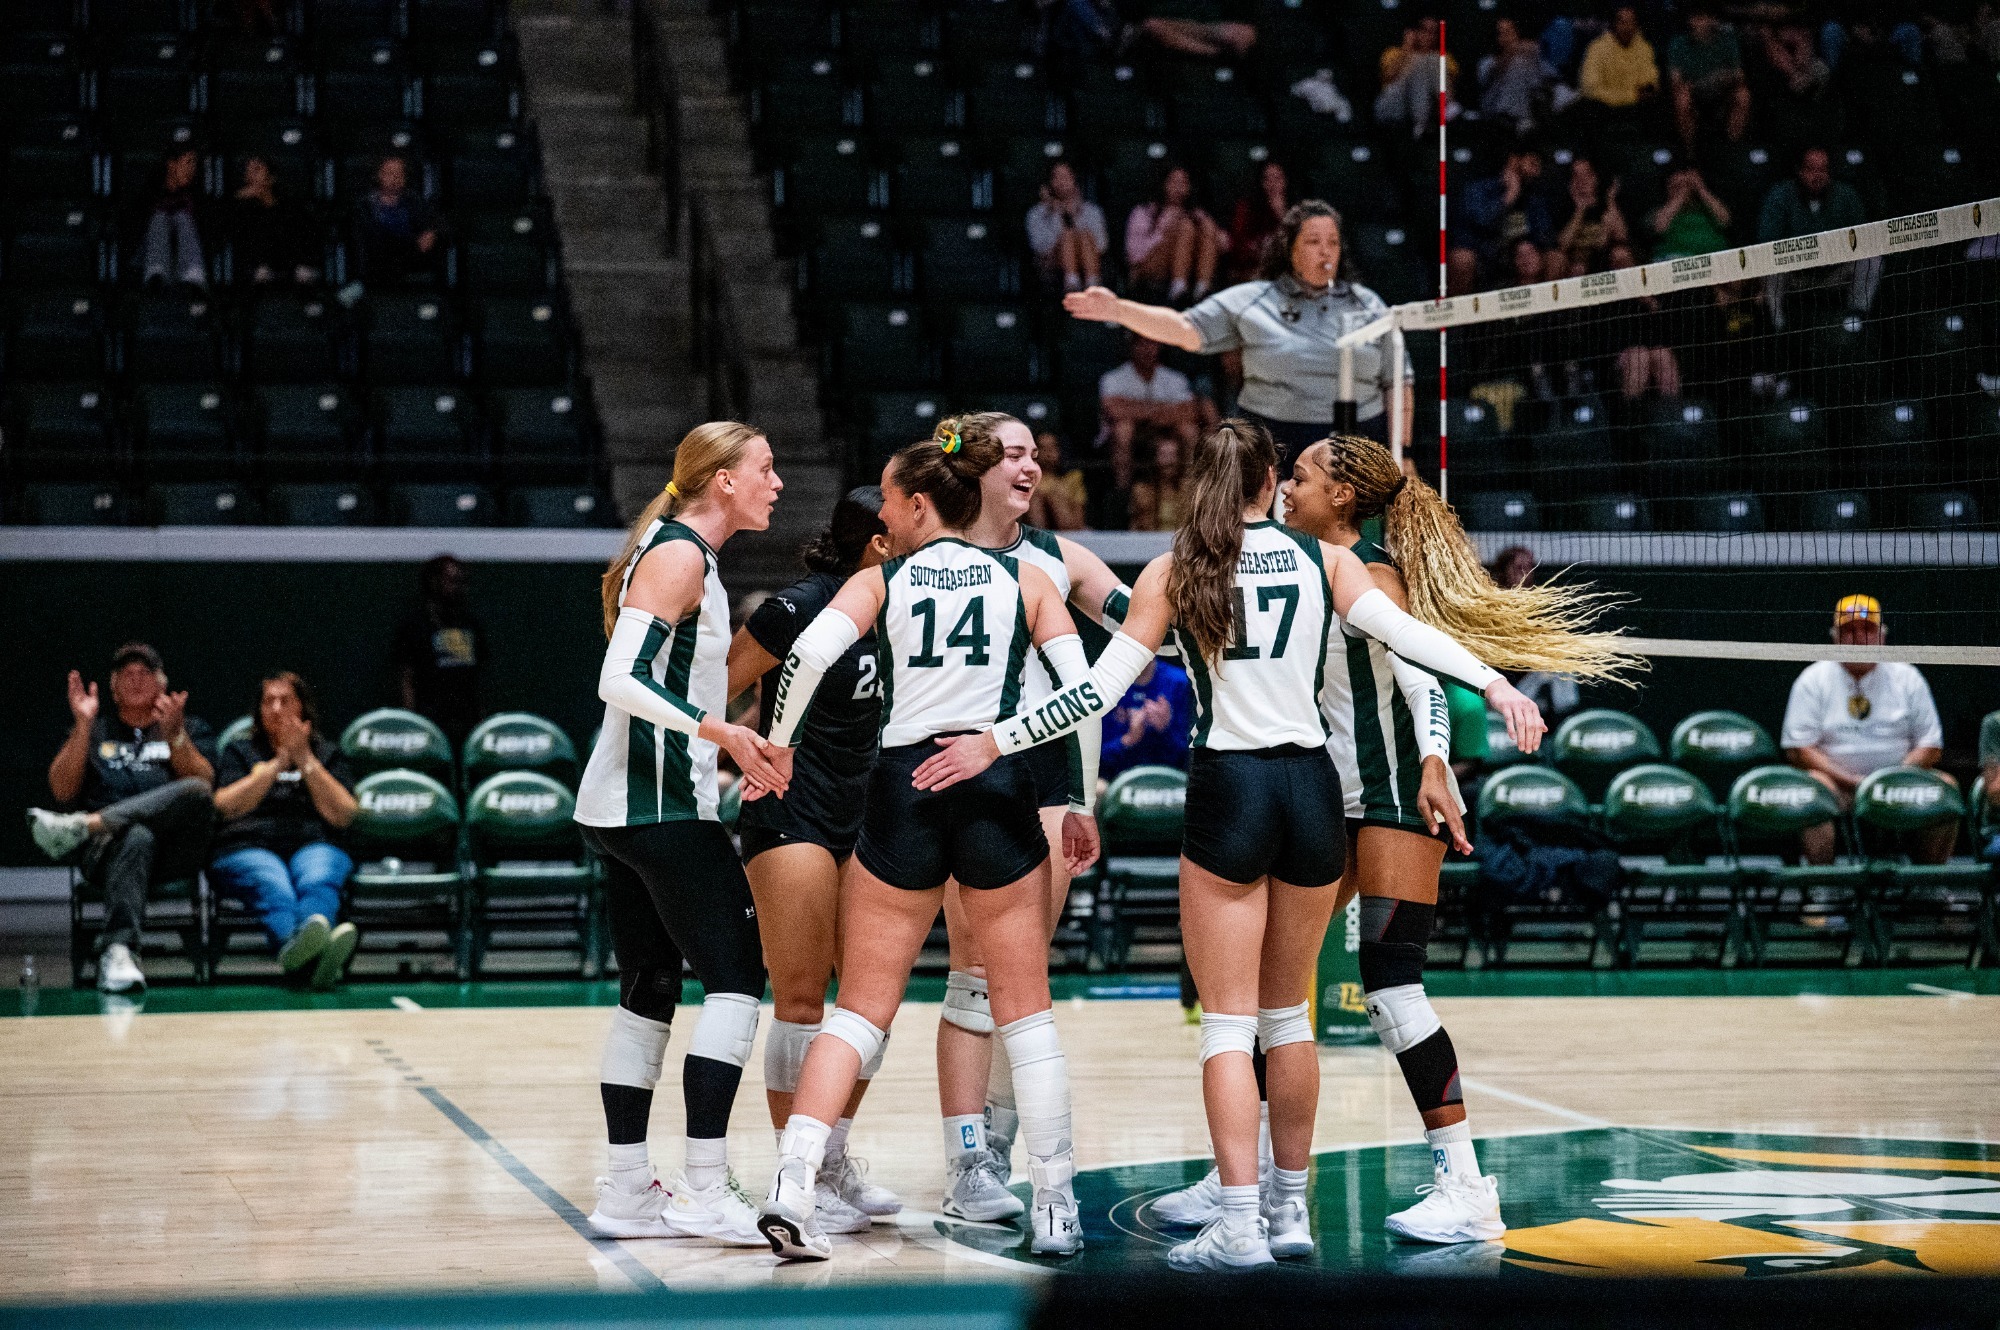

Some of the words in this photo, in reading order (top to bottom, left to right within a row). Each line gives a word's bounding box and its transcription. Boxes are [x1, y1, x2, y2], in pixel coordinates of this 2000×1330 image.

[1887, 211, 1938, 234] SOUTHEASTERN
[910, 564, 992, 591] SOUTHEASTERN
[1235, 548, 1299, 575] HEASTERN
[907, 595, 991, 667] 14
[1222, 584, 1300, 660] 17
[851, 654, 884, 700] 2
[1021, 681, 1104, 744] LIONS
